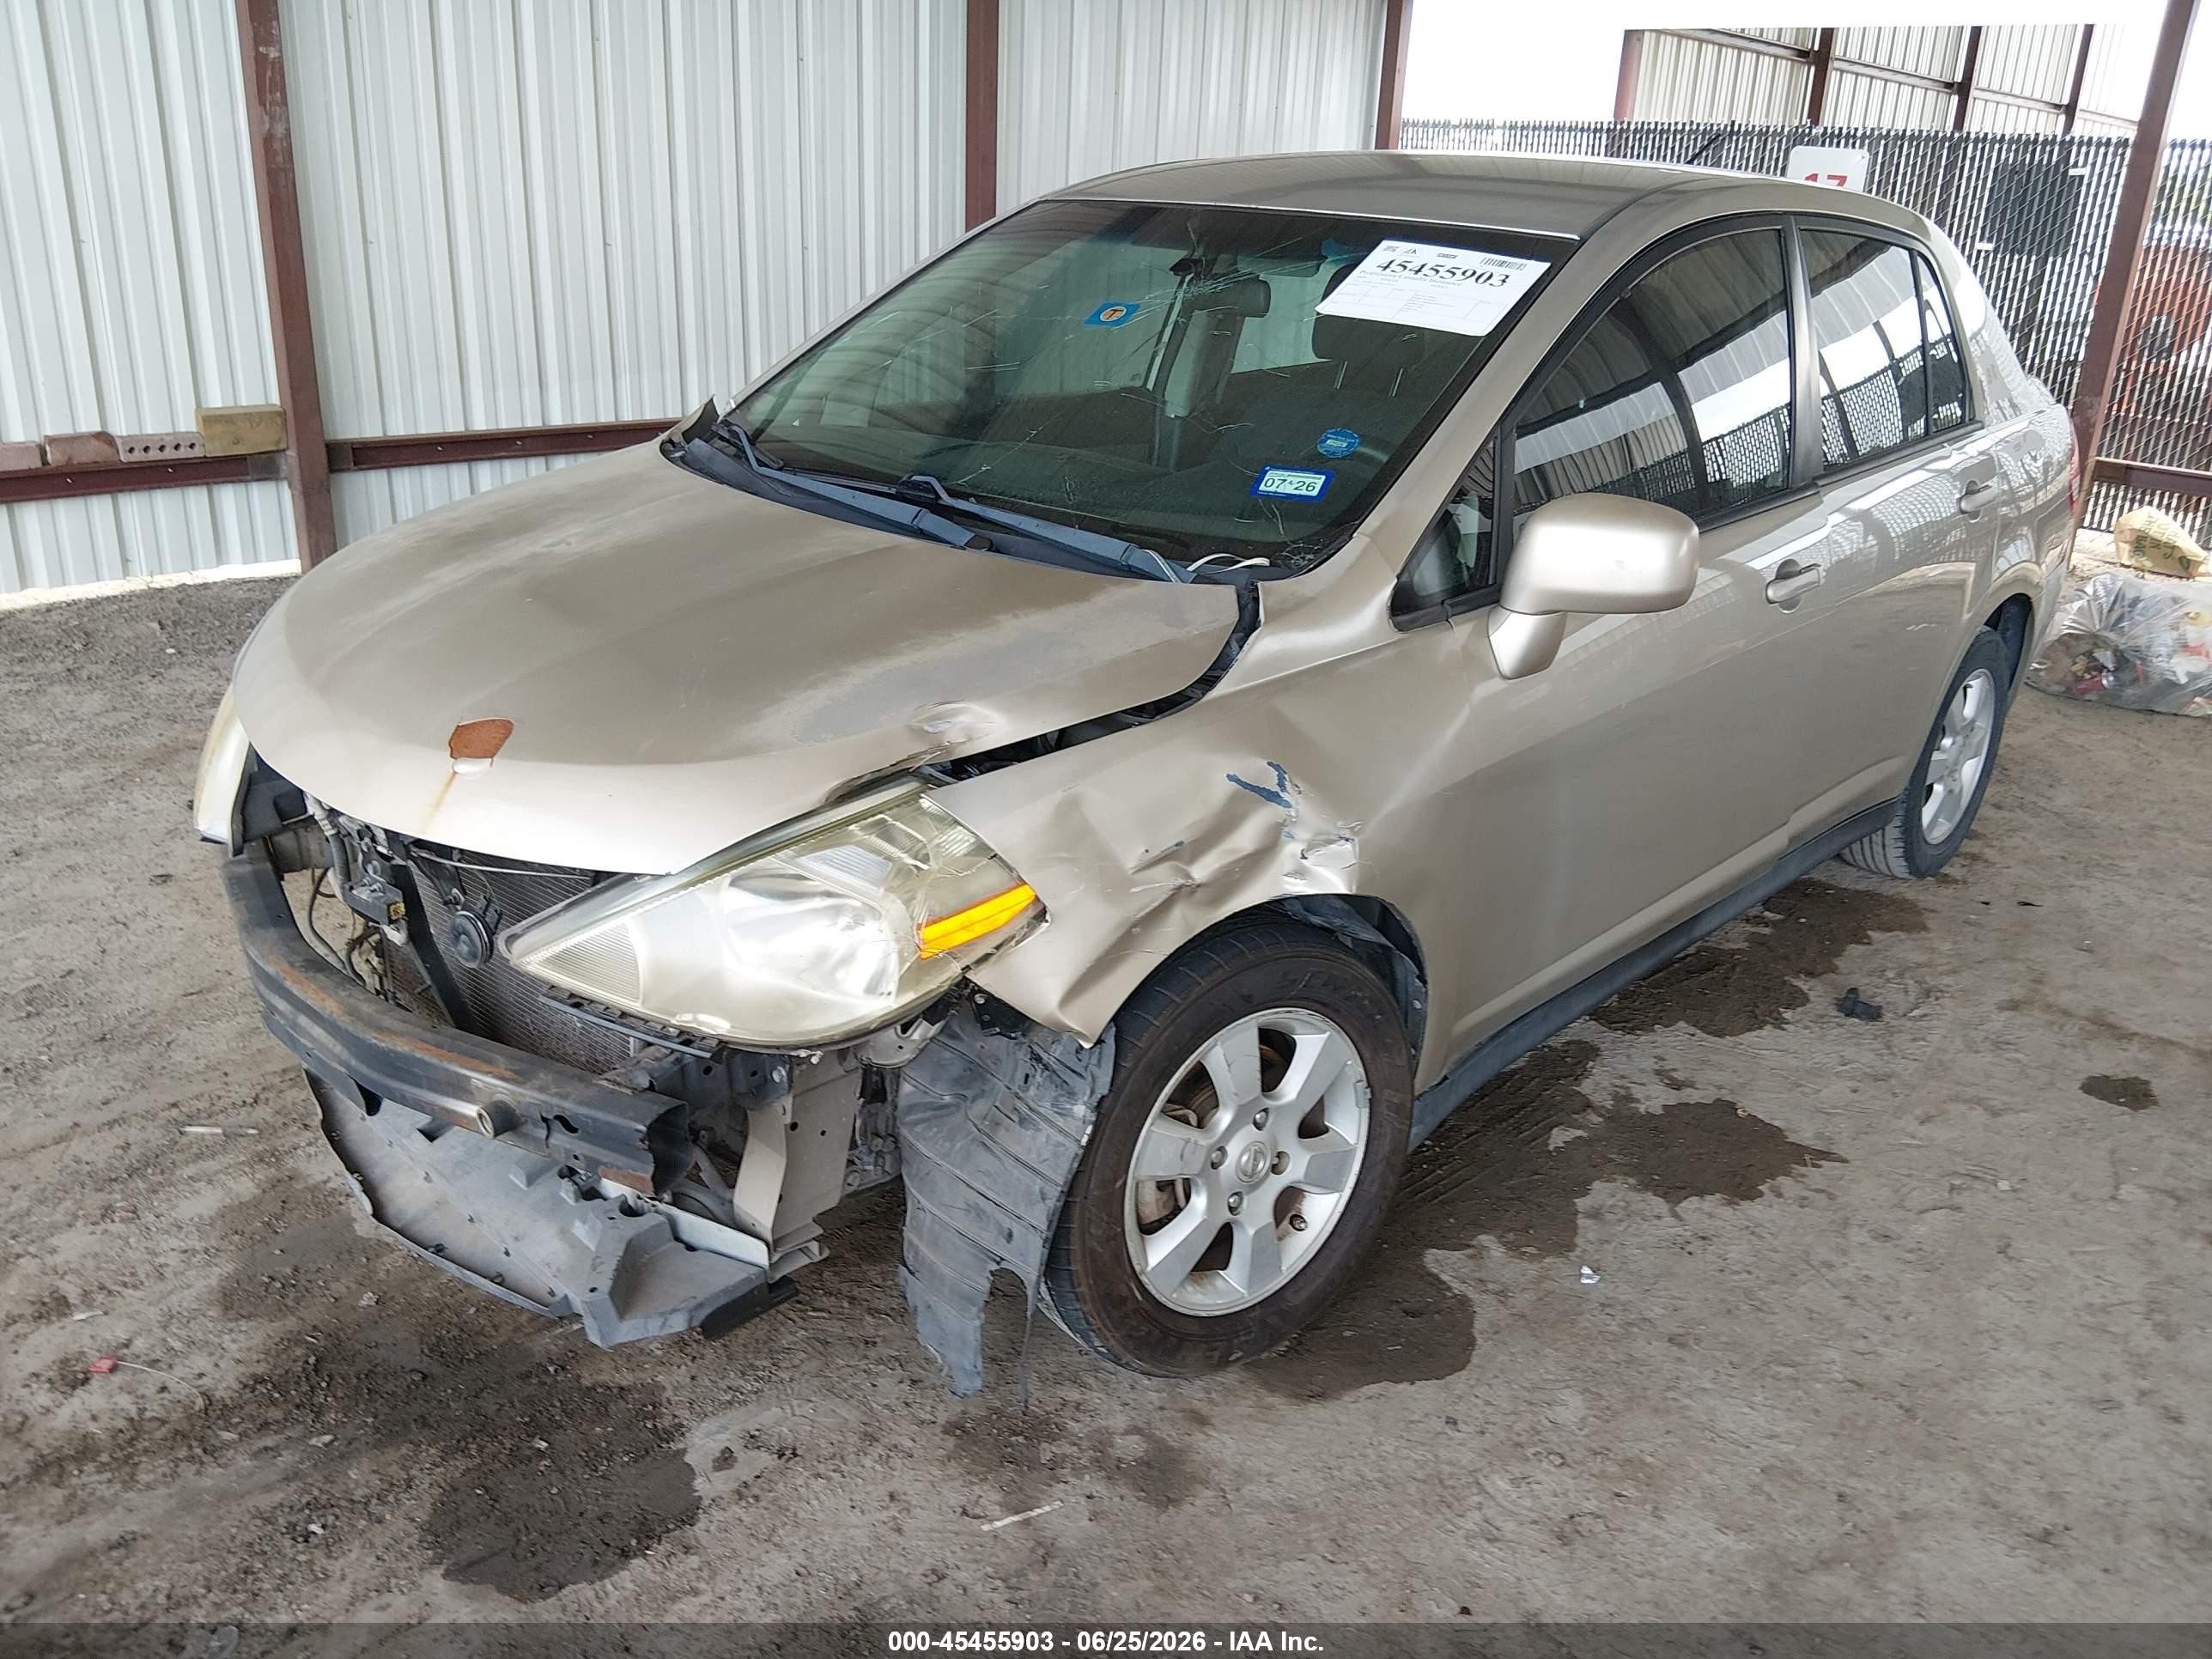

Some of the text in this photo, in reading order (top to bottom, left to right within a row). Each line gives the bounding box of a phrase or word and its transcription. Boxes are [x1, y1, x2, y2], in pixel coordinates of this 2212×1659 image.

[1376, 258, 1510, 288] 45455903
[1263, 477, 1317, 492] 07 26
